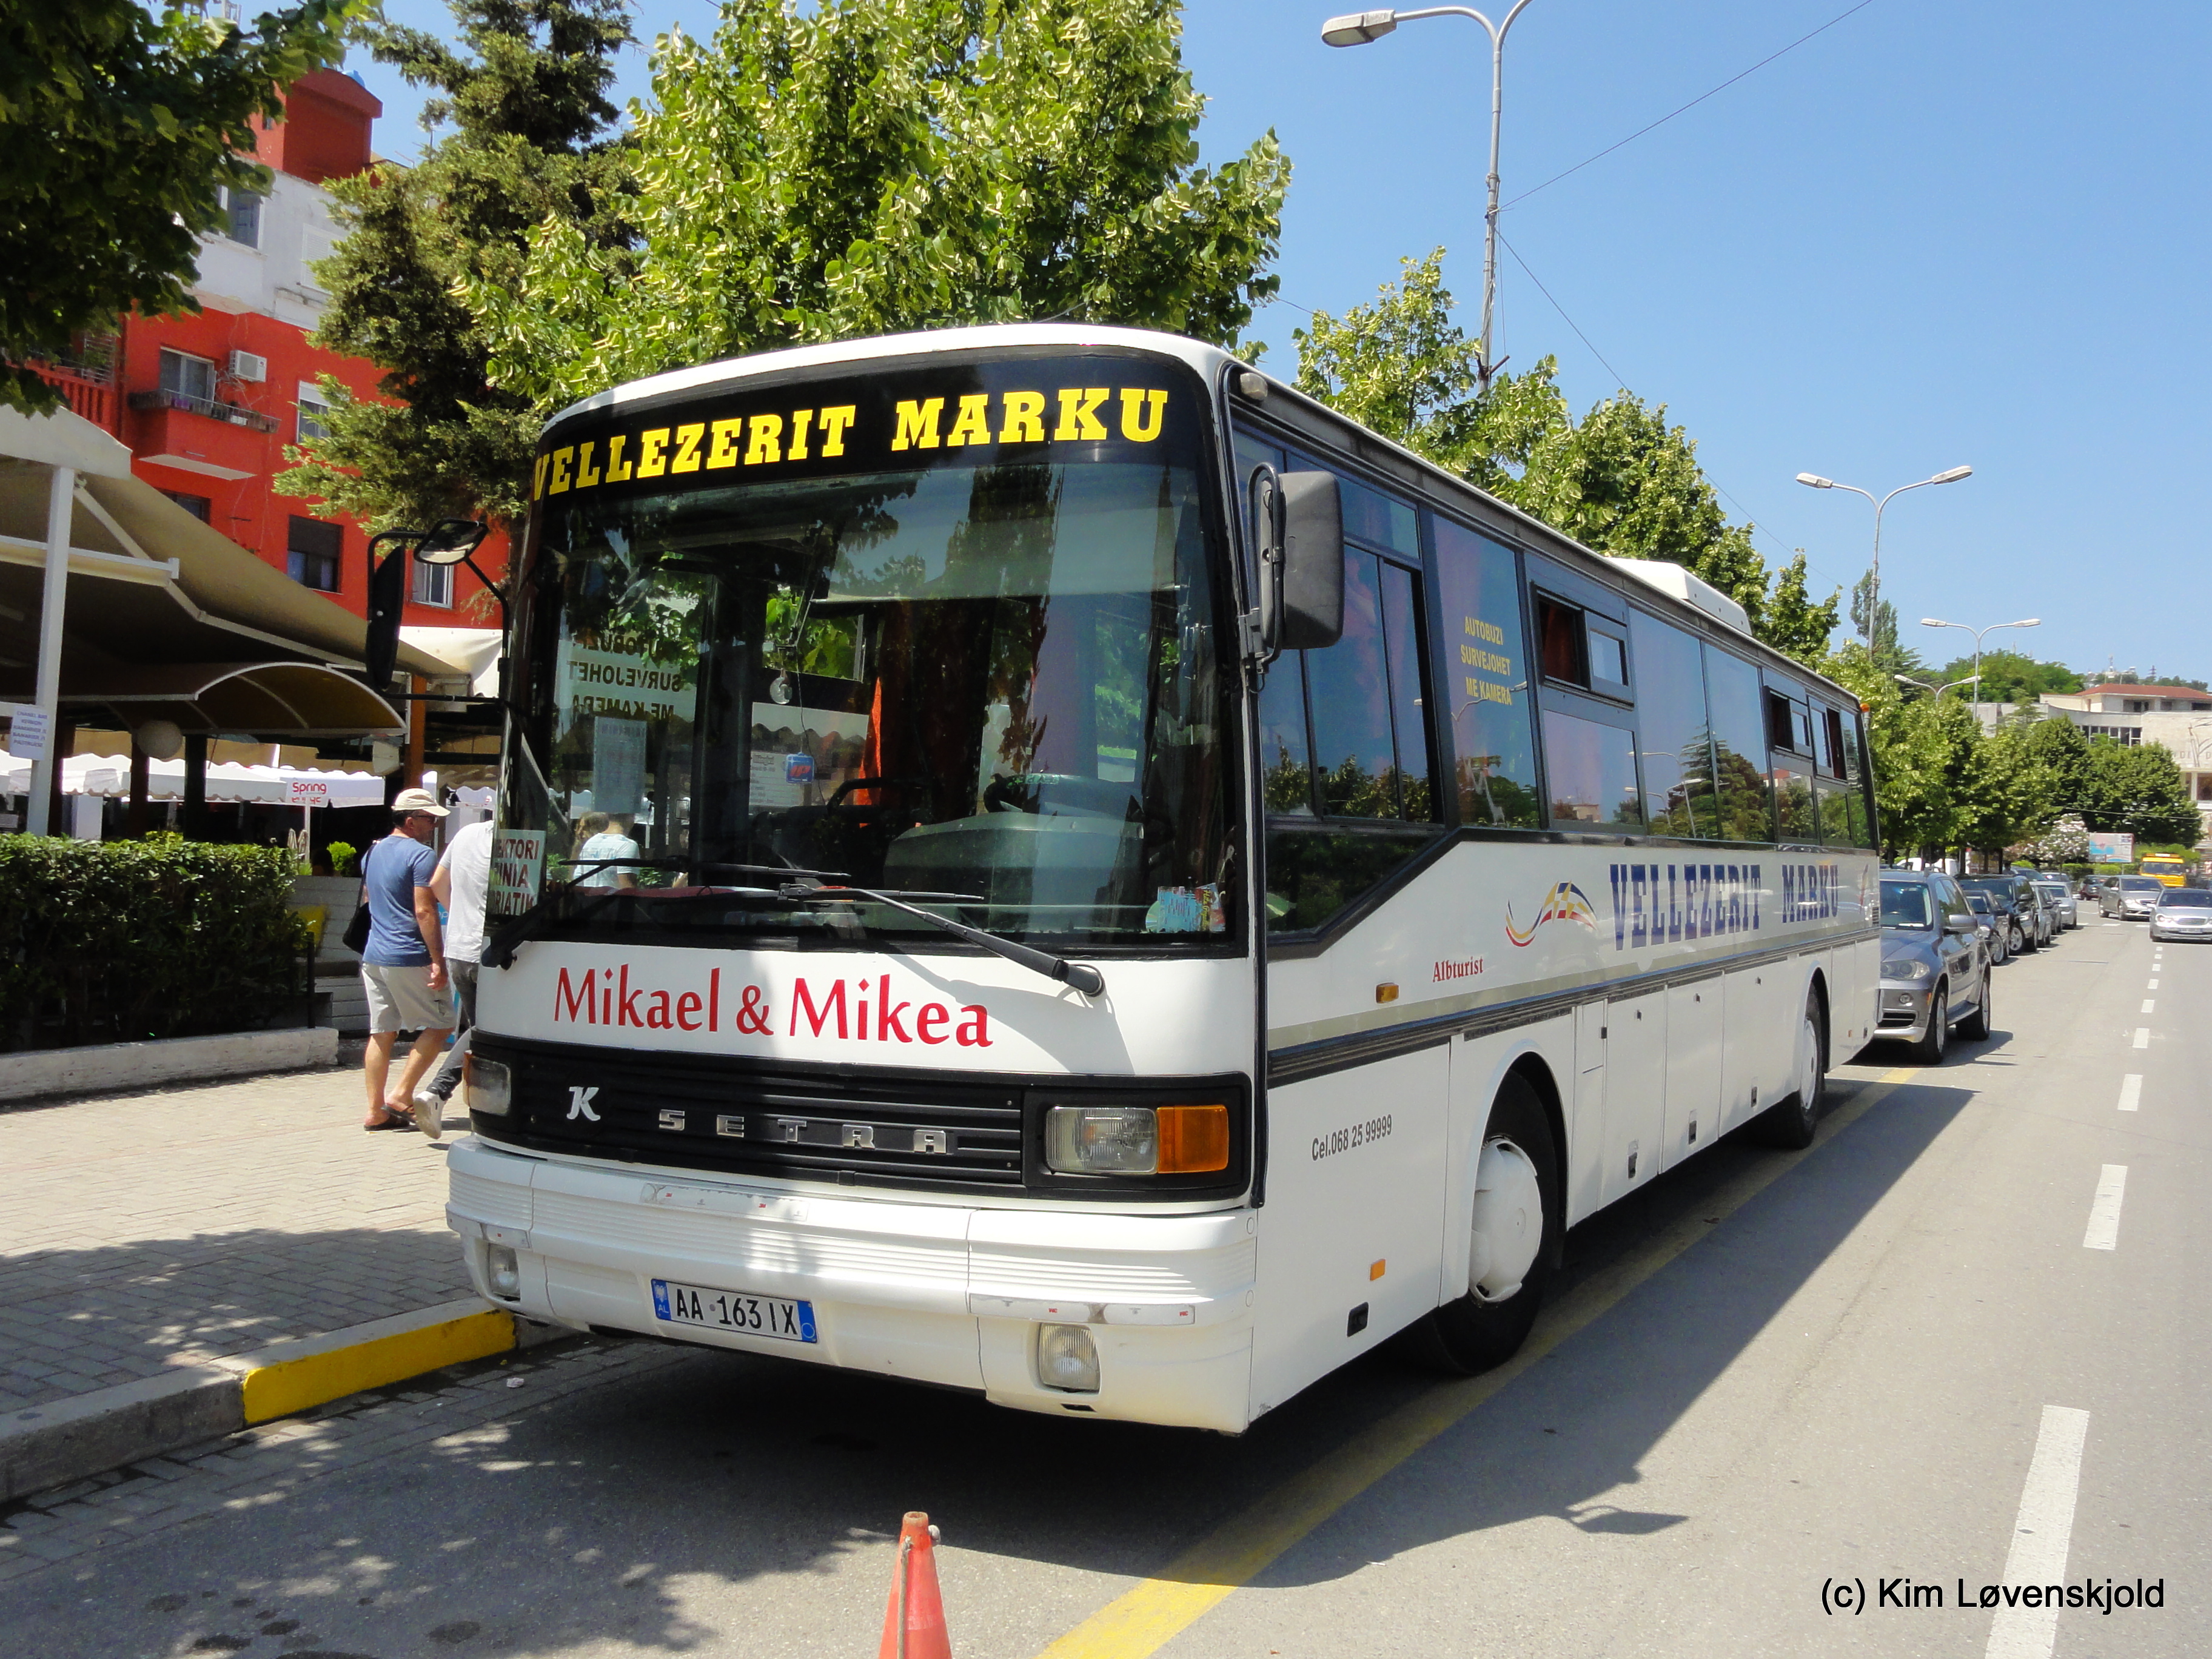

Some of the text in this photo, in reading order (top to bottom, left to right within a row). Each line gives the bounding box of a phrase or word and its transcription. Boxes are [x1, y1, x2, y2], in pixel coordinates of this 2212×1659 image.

[534, 387, 1169, 501] VELLEZERIT MARKU
[1464, 615, 1504, 646] AUTOBUZI
[1460, 644, 1511, 677] SURVEJOHET
[1466, 676, 1512, 706] ME KAMERA
[292, 782, 327, 796] Spring
[1609, 863, 1838, 951] VELLEZERIT MARKU
[1432, 956, 1484, 983] Albturist
[554, 963, 994, 1047] Mikael & Mikea
[566, 1085, 601, 1121] K
[658, 1108, 947, 1154] SETRA
[1312, 1113, 1392, 1161] Cel.068 25 99999
[658, 1303, 669, 1313] AL
[676, 1288, 798, 1335] AA 163 IX
